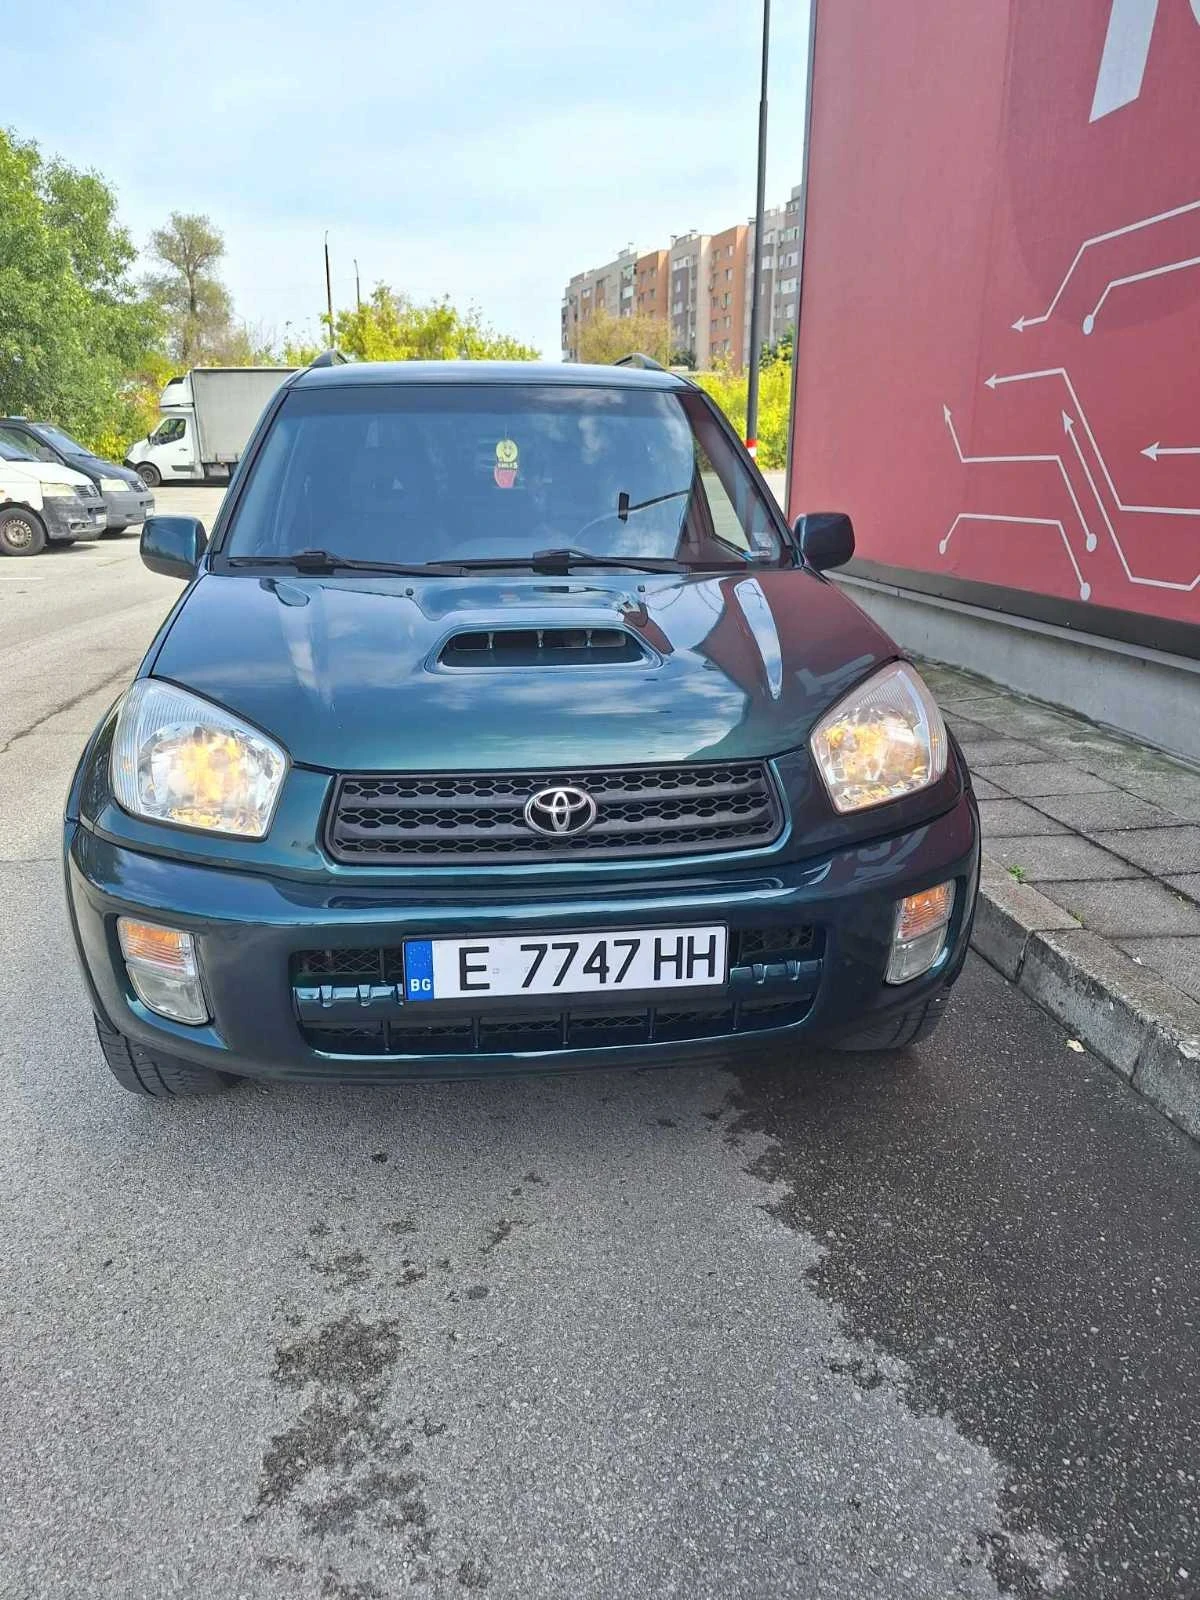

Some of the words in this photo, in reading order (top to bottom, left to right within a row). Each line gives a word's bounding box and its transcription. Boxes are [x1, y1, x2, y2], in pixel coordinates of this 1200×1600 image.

[459, 946, 490, 991] E
[520, 938, 641, 988] 7747
[653, 934, 717, 981] HH
[410, 978, 431, 992] BG
